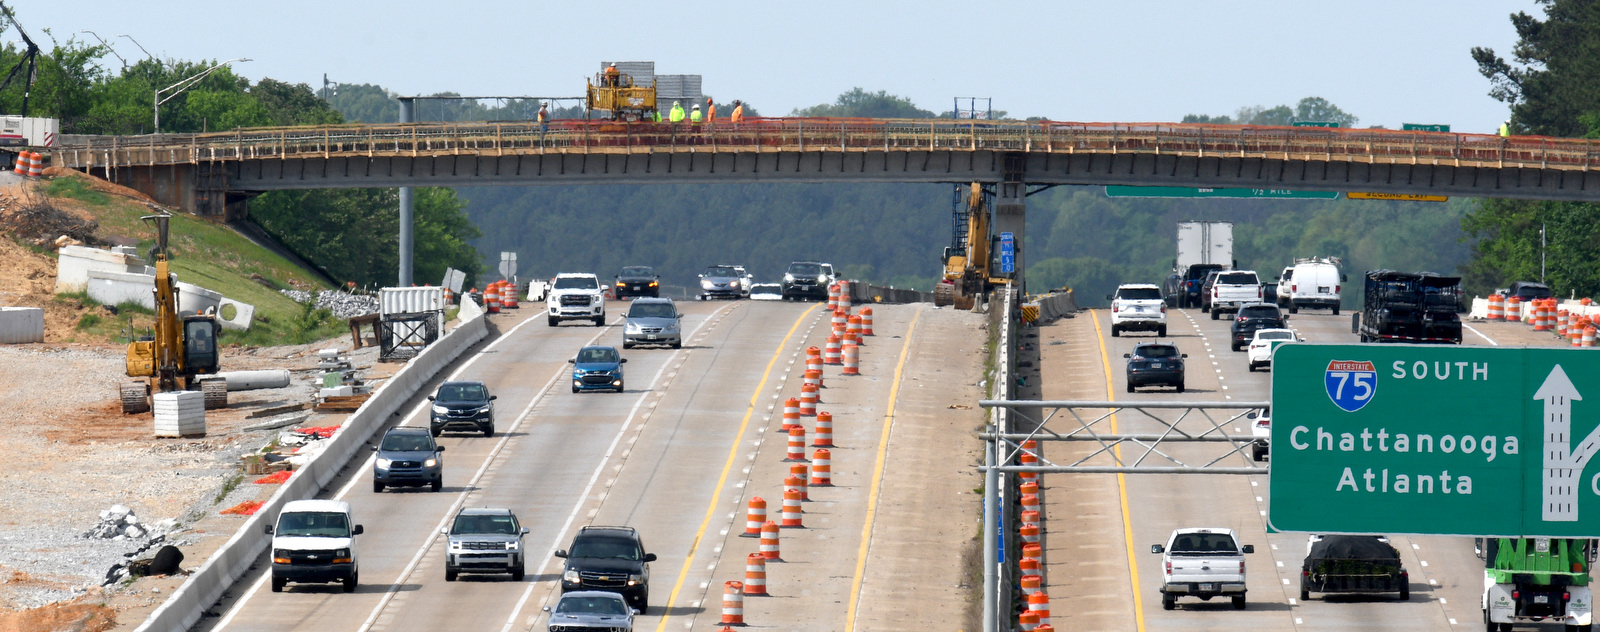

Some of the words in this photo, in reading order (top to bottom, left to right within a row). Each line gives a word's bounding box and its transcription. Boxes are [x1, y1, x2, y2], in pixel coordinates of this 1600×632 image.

[1333, 363, 1370, 371] INTERSTATE
[1392, 360, 1488, 381] SOUTH
[1330, 372, 1372, 401] 75
[1290, 425, 1519, 463] Chattanooga
[1336, 467, 1473, 495] Atlanta
